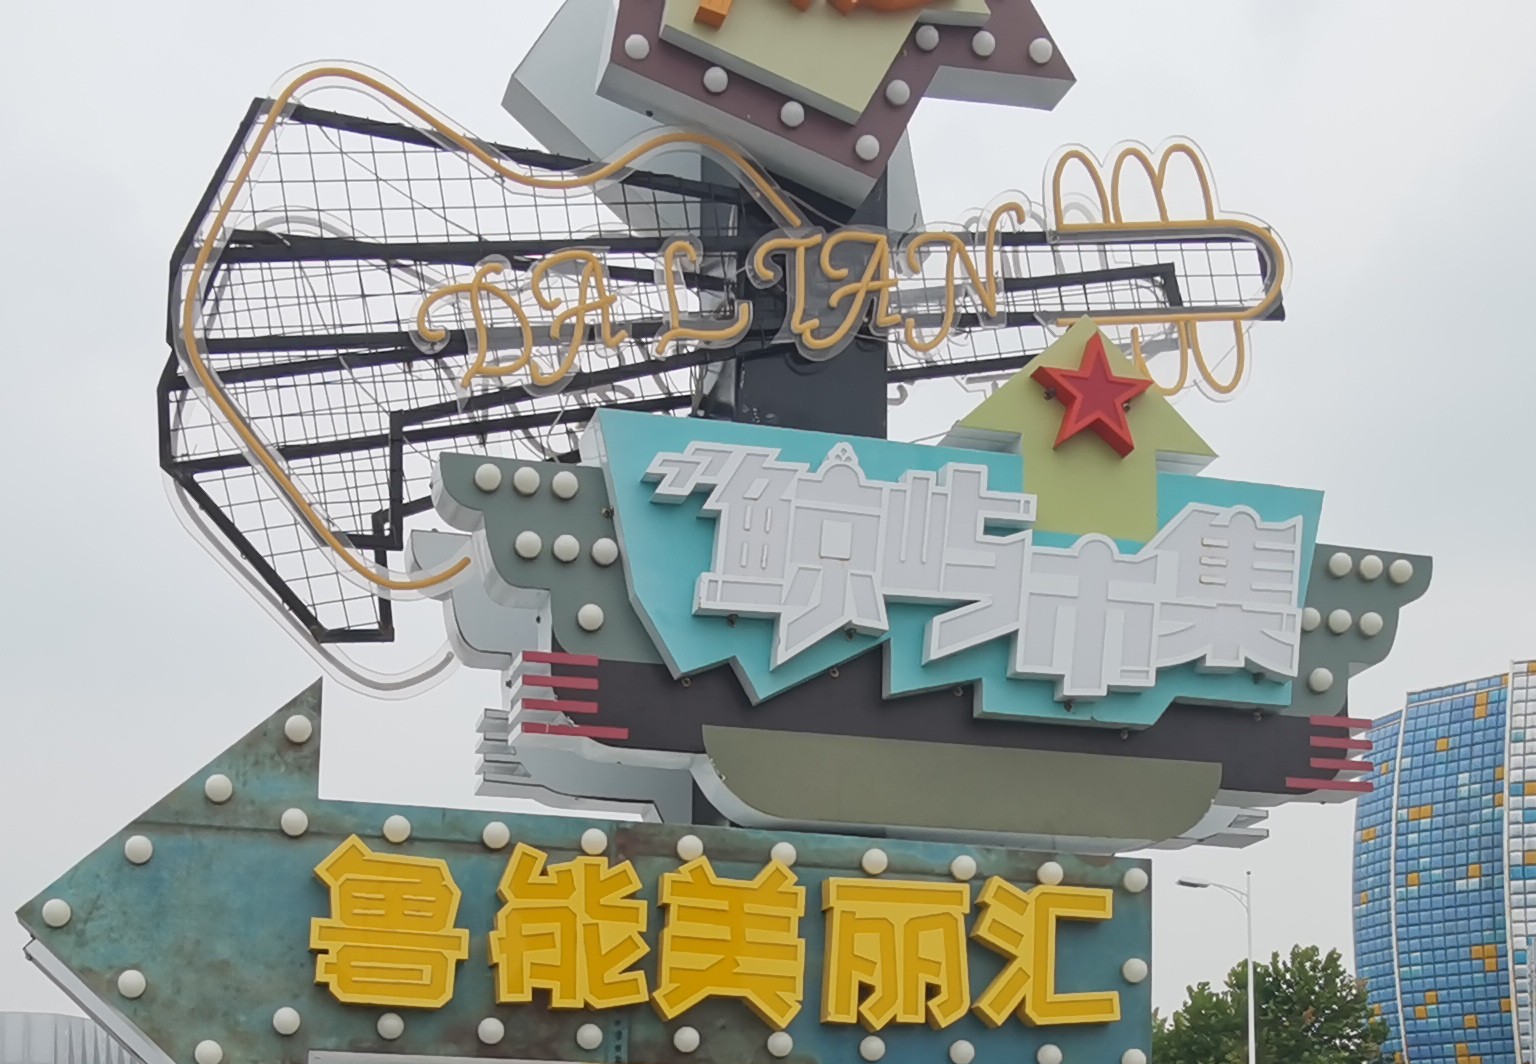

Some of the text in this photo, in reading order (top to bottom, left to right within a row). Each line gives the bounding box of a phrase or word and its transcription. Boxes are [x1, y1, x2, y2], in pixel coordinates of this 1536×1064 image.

[639, 441, 1303, 699] 鲸屿市集
[309, 834, 1121, 1031] 鲁能美丽汇
